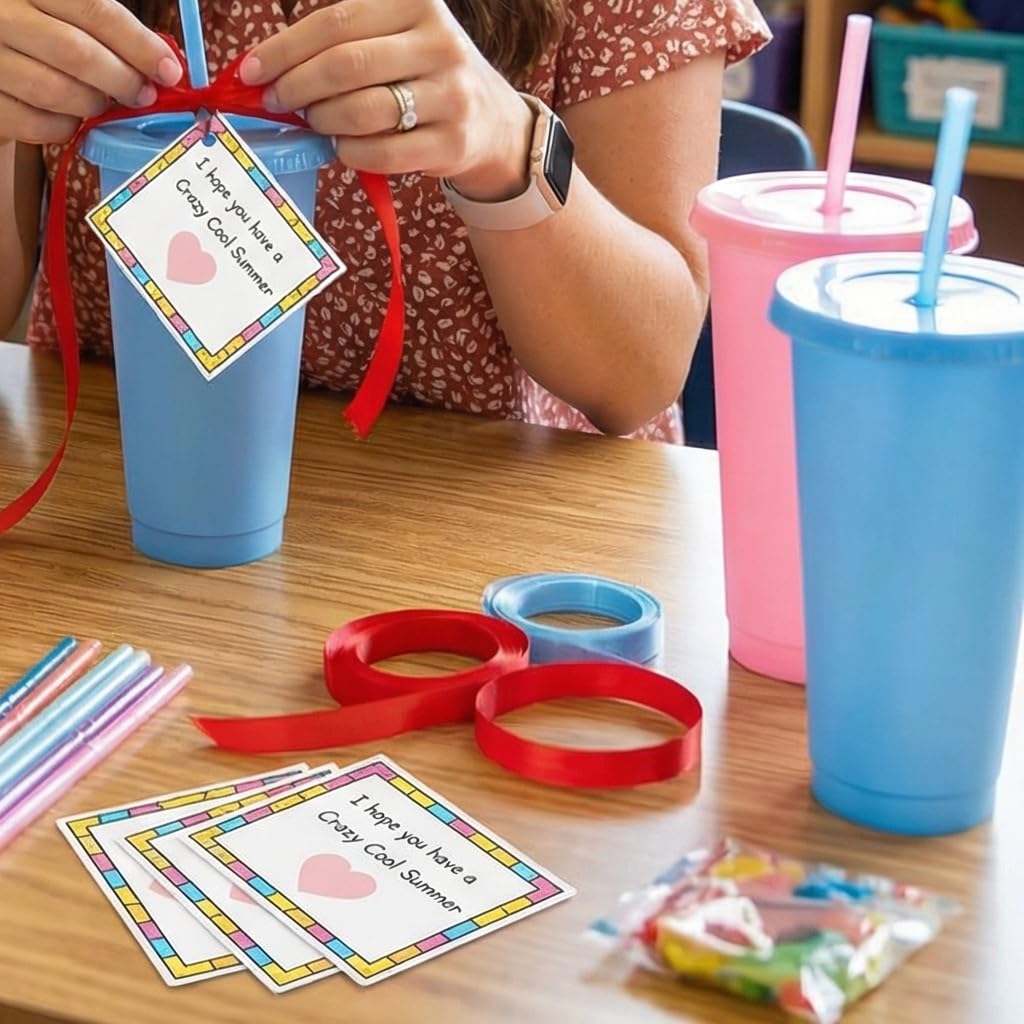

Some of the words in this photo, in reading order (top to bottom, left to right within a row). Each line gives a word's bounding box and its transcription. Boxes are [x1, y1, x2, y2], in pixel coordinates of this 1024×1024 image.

[176, 179, 208, 218] Crazy
[207, 217, 237, 248] Cool
[231, 246, 273, 295] Summer
[196, 157, 210, 170] I
[205, 167, 231, 199] hope
[225, 200, 251, 223] you
[248, 220, 273, 252] have
[273, 253, 283, 263] a
[318, 811, 364, 843] Crazy
[364, 844, 407, 869] Cool
[400, 869, 461, 913] Summer
[350, 794, 369, 806] I
[364, 803, 400, 830] hope
[394, 831, 427, 849] you
[426, 847, 463, 875] have
[463, 876, 477, 885] a
